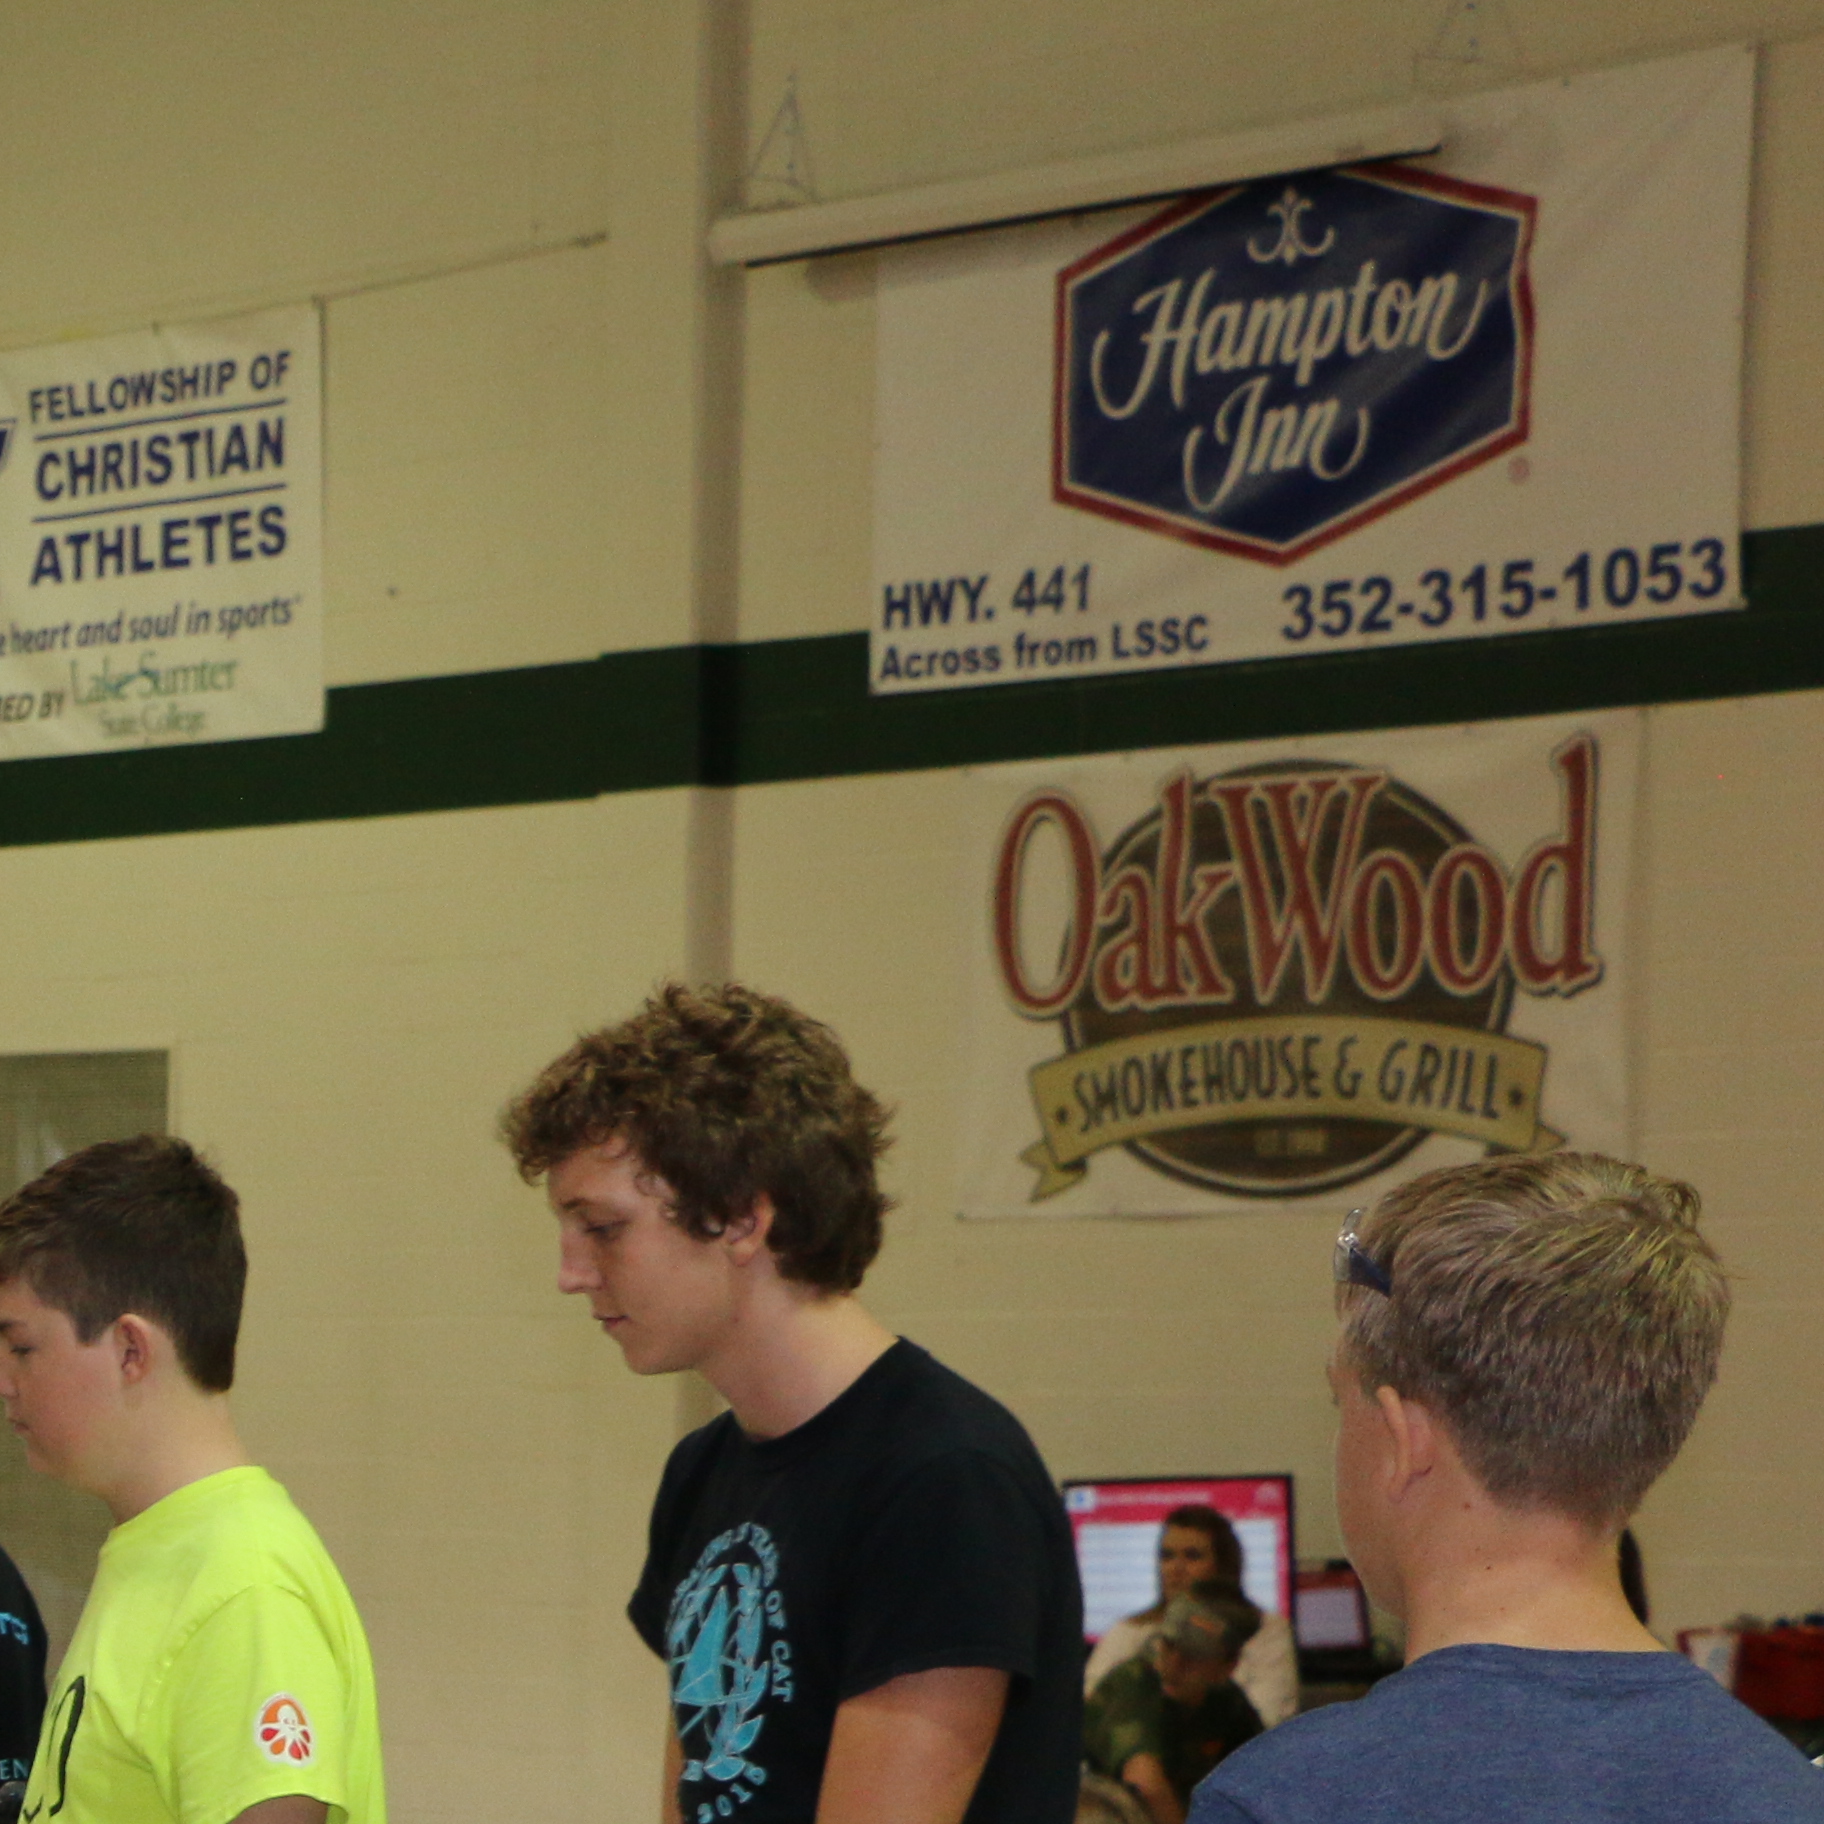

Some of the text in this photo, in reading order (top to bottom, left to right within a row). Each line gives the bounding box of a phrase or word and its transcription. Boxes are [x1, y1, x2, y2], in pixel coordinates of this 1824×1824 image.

[1090, 260, 1488, 420] Hampton
[29, 350, 292, 424] FELLOWSHIP OF
[35, 418, 286, 502] CHRISTIAN
[1184, 376, 1371, 514] Inn
[29, 505, 288, 588] ATHLETES
[10, 617, 71, 656] heart
[77, 611, 122, 648] and
[128, 602, 179, 642] soul
[186, 599, 211, 635] in
[218, 594, 293, 643] sports
[884, 566, 1092, 632] HWY. 441
[1281, 537, 1728, 643] 352-315-1053
[880, 615, 1210, 683] Across from LSSC
[37, 688, 67, 722] BY
[1073, 1035, 1502, 1133] SMOKEHOUSE & GRILL
